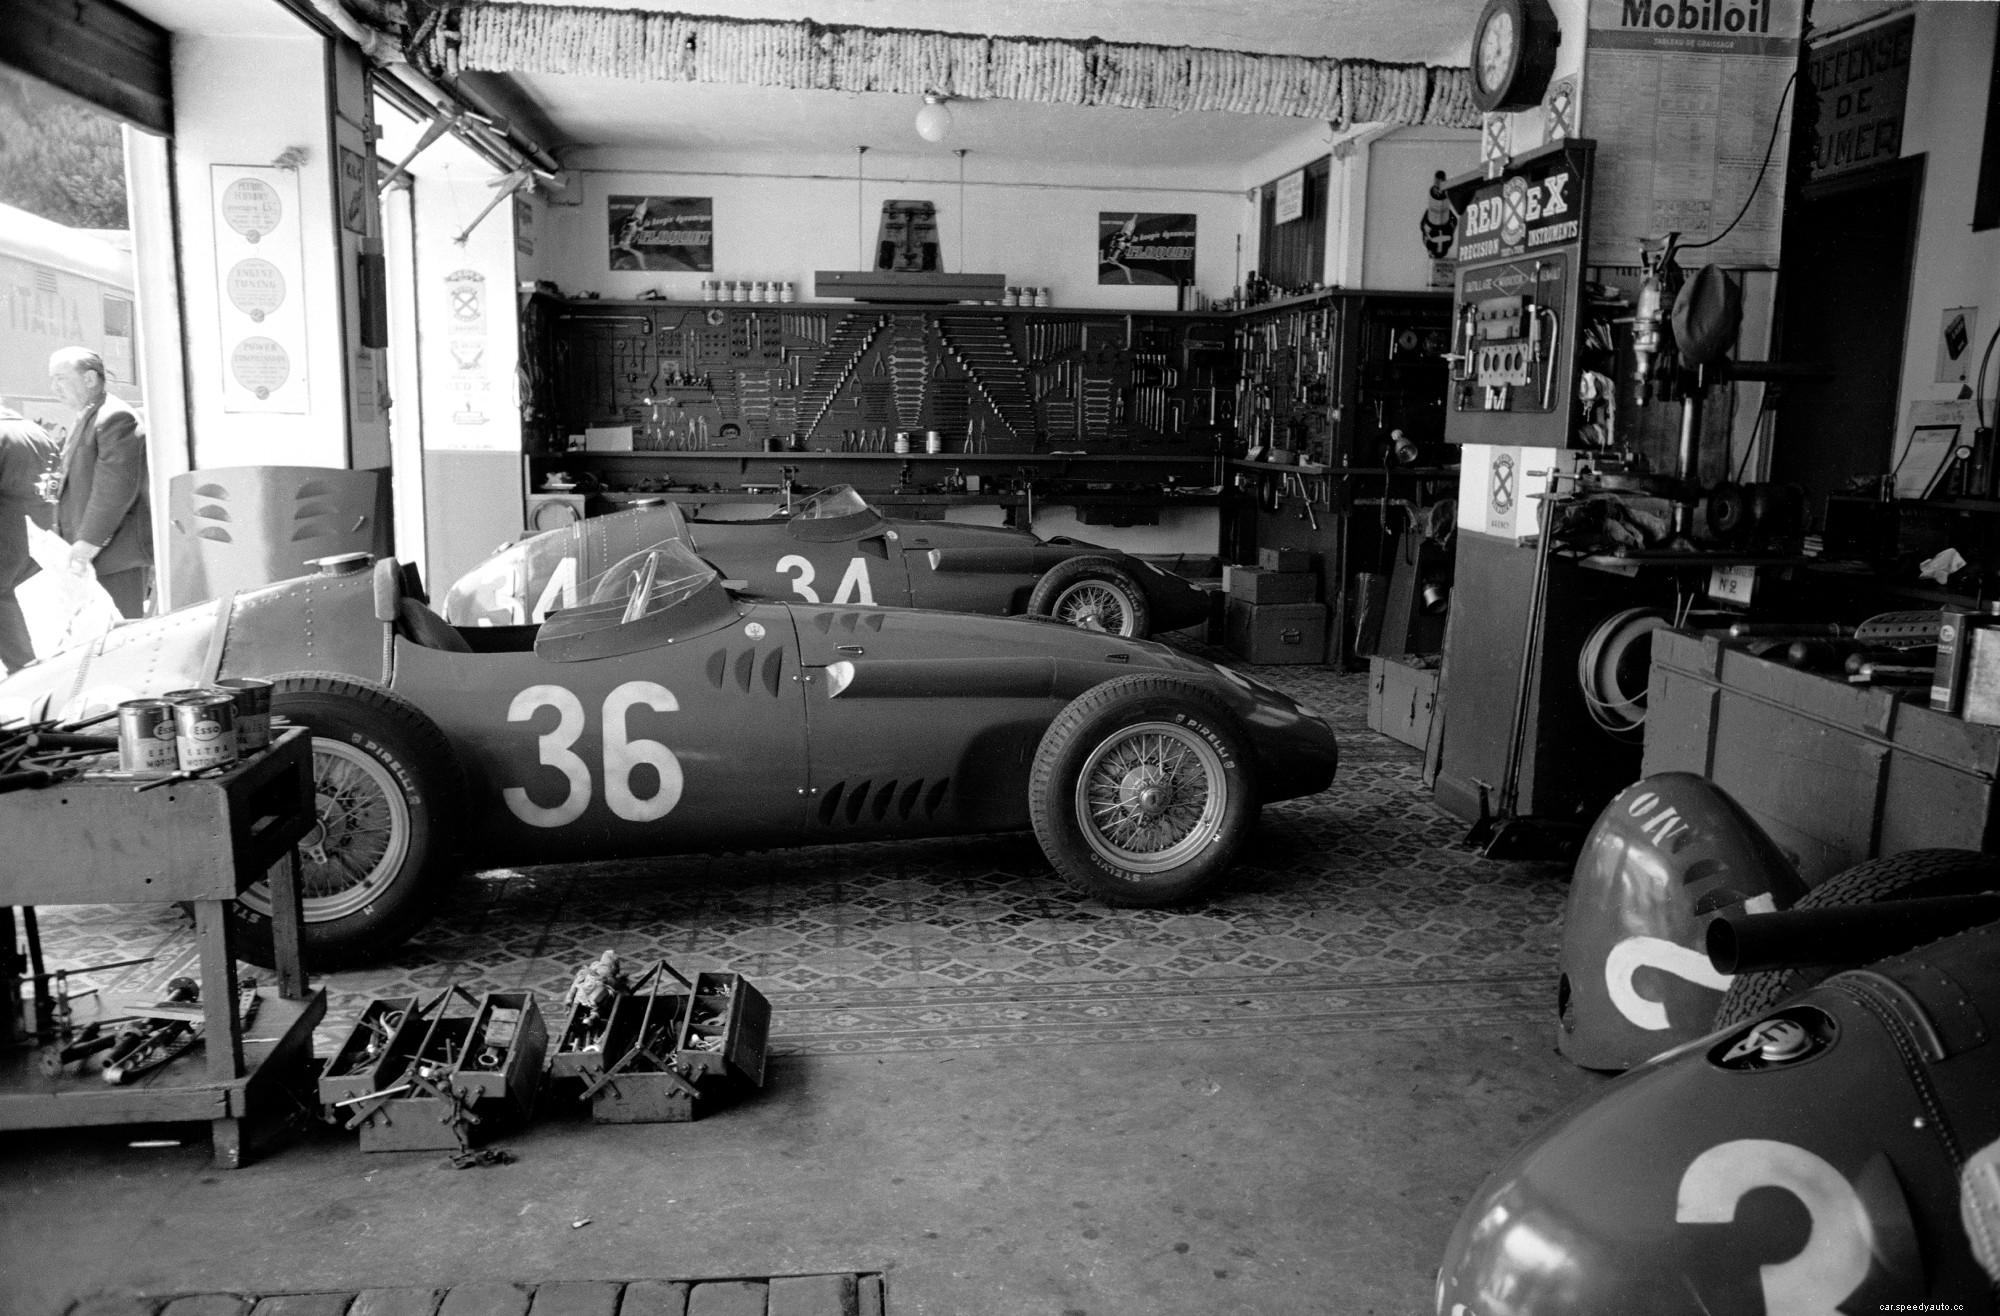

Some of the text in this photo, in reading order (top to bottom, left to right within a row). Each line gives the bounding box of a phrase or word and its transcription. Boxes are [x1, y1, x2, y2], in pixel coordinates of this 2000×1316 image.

[1622, 0, 1771, 33] Mobiloil
[1654, 37, 1685, 46] TABLEAU
[1686, 39, 1695, 47] DE
[1836, 86, 1873, 119] DE
[1816, 119, 1898, 170] UMER
[636, 230, 712, 246] FLOQUET
[1528, 220, 1579, 247] INSTRUMENTS
[1124, 246, 1194, 260] FLOQUET
[1459, 239, 1499, 261] PRECISION
[502, 680, 684, 828] 36
[1187, 718, 1230, 759] PIRELLI
[365, 740, 416, 793] PIRELLI
[1090, 852, 1142, 883] STELVIO
